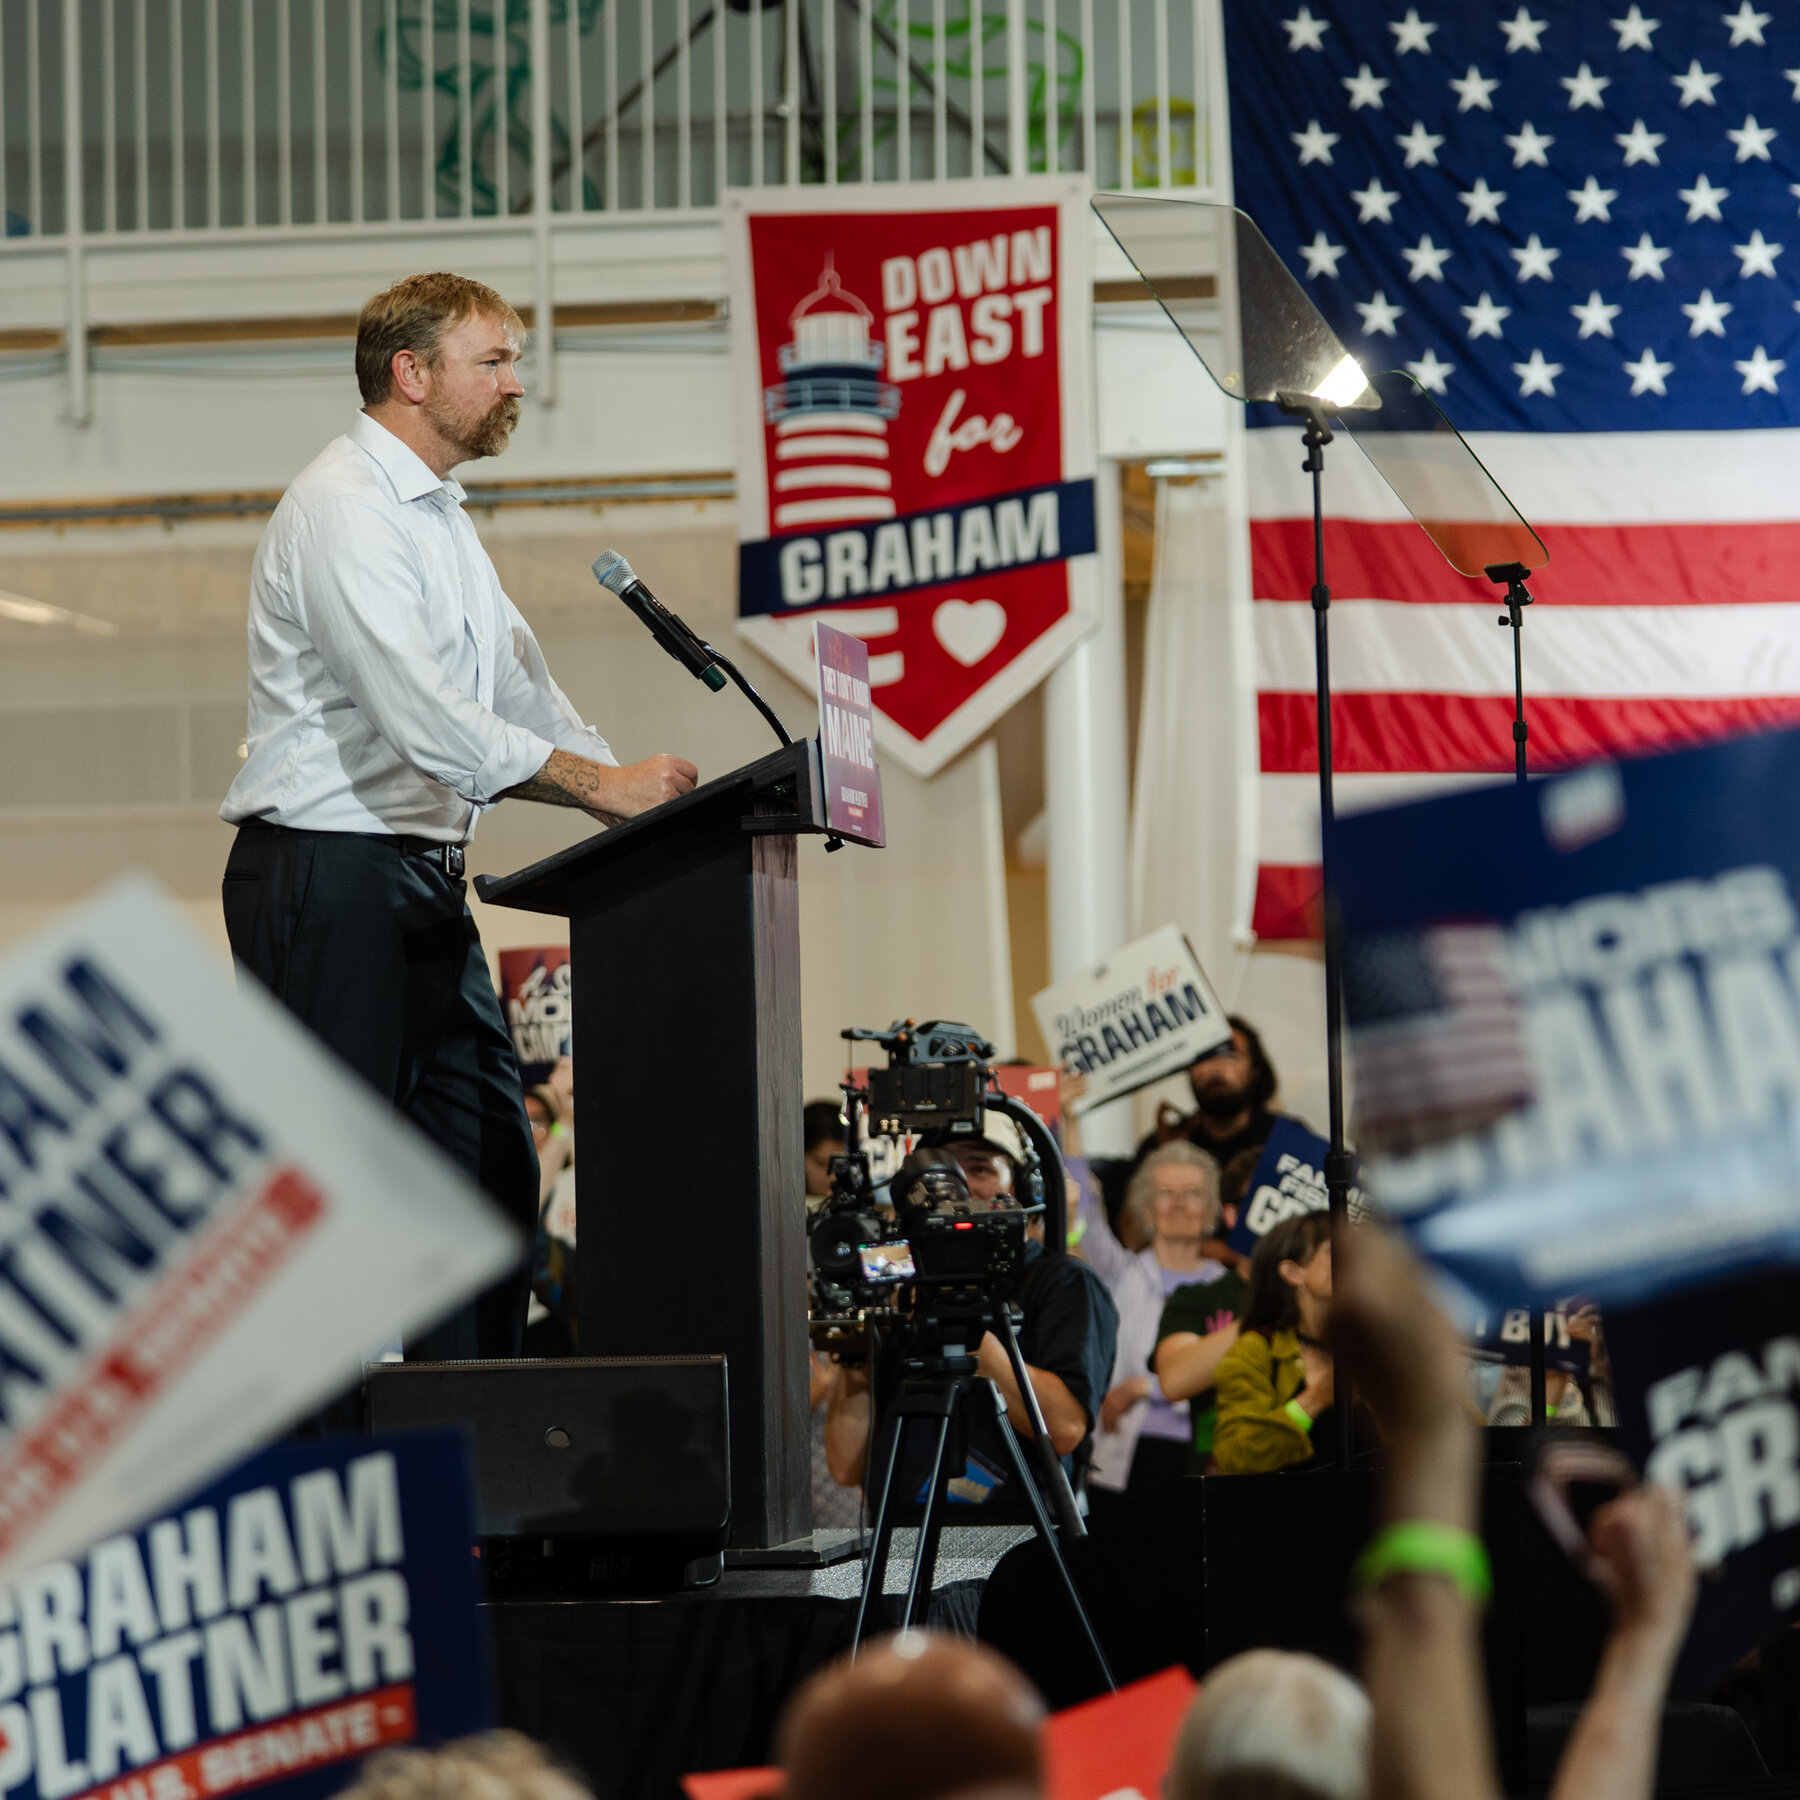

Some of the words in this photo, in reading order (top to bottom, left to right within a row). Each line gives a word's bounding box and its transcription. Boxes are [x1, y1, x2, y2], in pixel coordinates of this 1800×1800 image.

[882, 226, 1052, 312] DOWN
[885, 287, 1053, 382] EAST
[924, 388, 1023, 477] for
[779, 491, 1060, 606] GRAHAM
[826, 703, 874, 769] MAINE
[1059, 981, 1208, 1074] GRAHAM
[199, 1701, 380, 1791] SENATE
